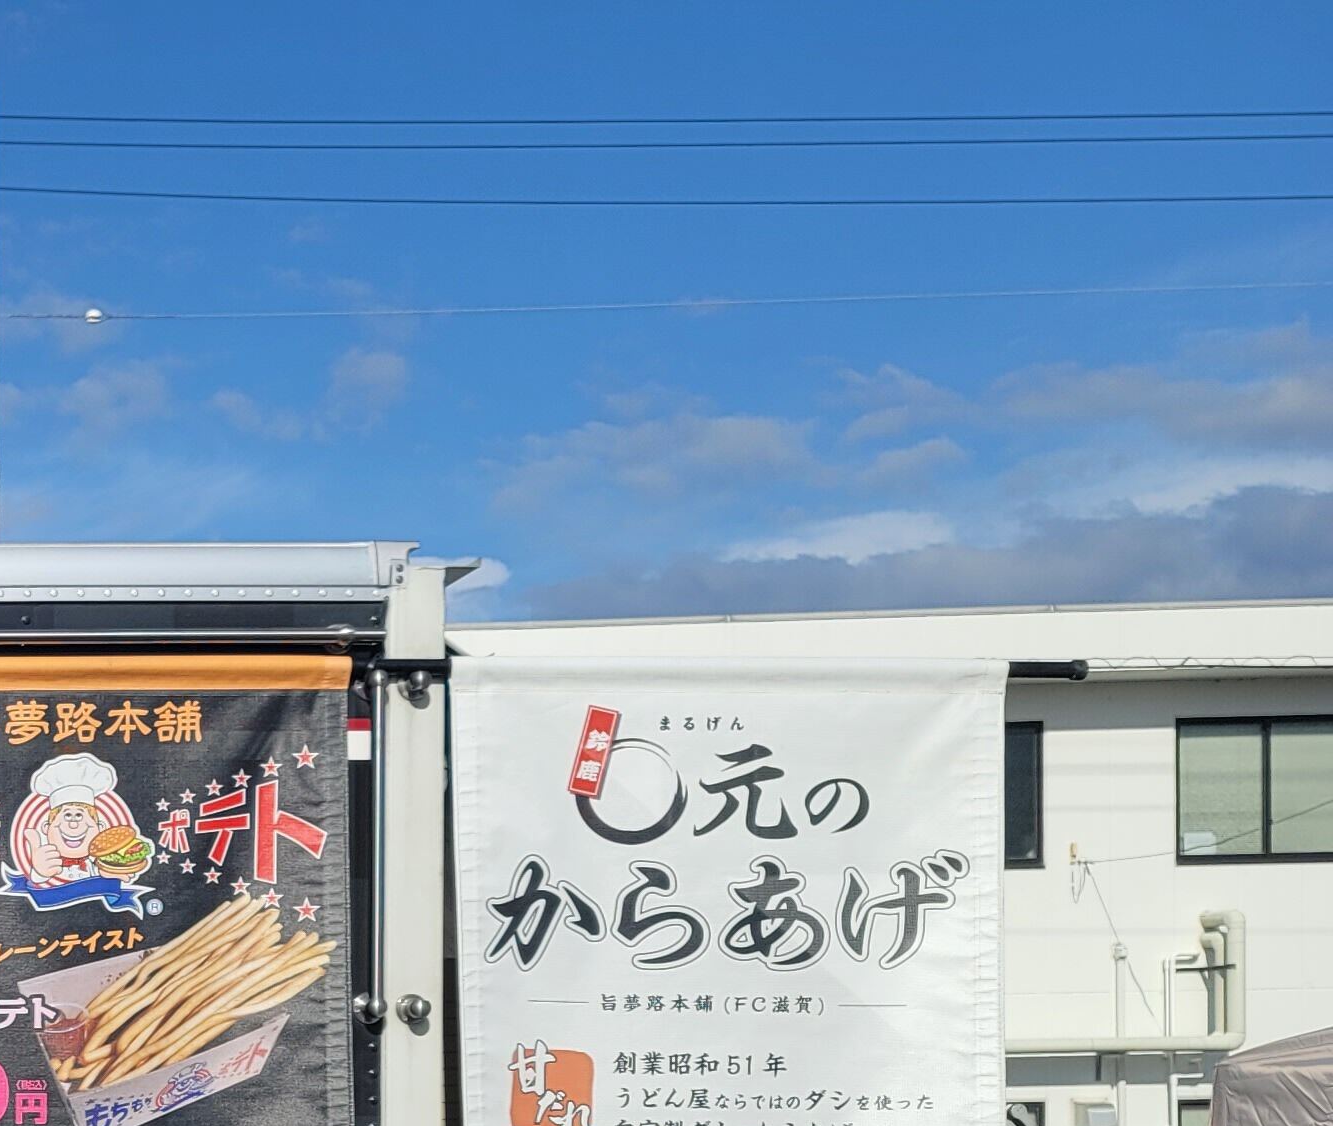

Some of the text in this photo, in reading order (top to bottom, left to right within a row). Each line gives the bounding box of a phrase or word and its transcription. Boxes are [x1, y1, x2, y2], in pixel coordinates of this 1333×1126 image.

[158, 780, 328, 883] ポテト
[484, 850, 971, 971] からあげ
[600, 993, 714, 1014] 旨夢路本舗
